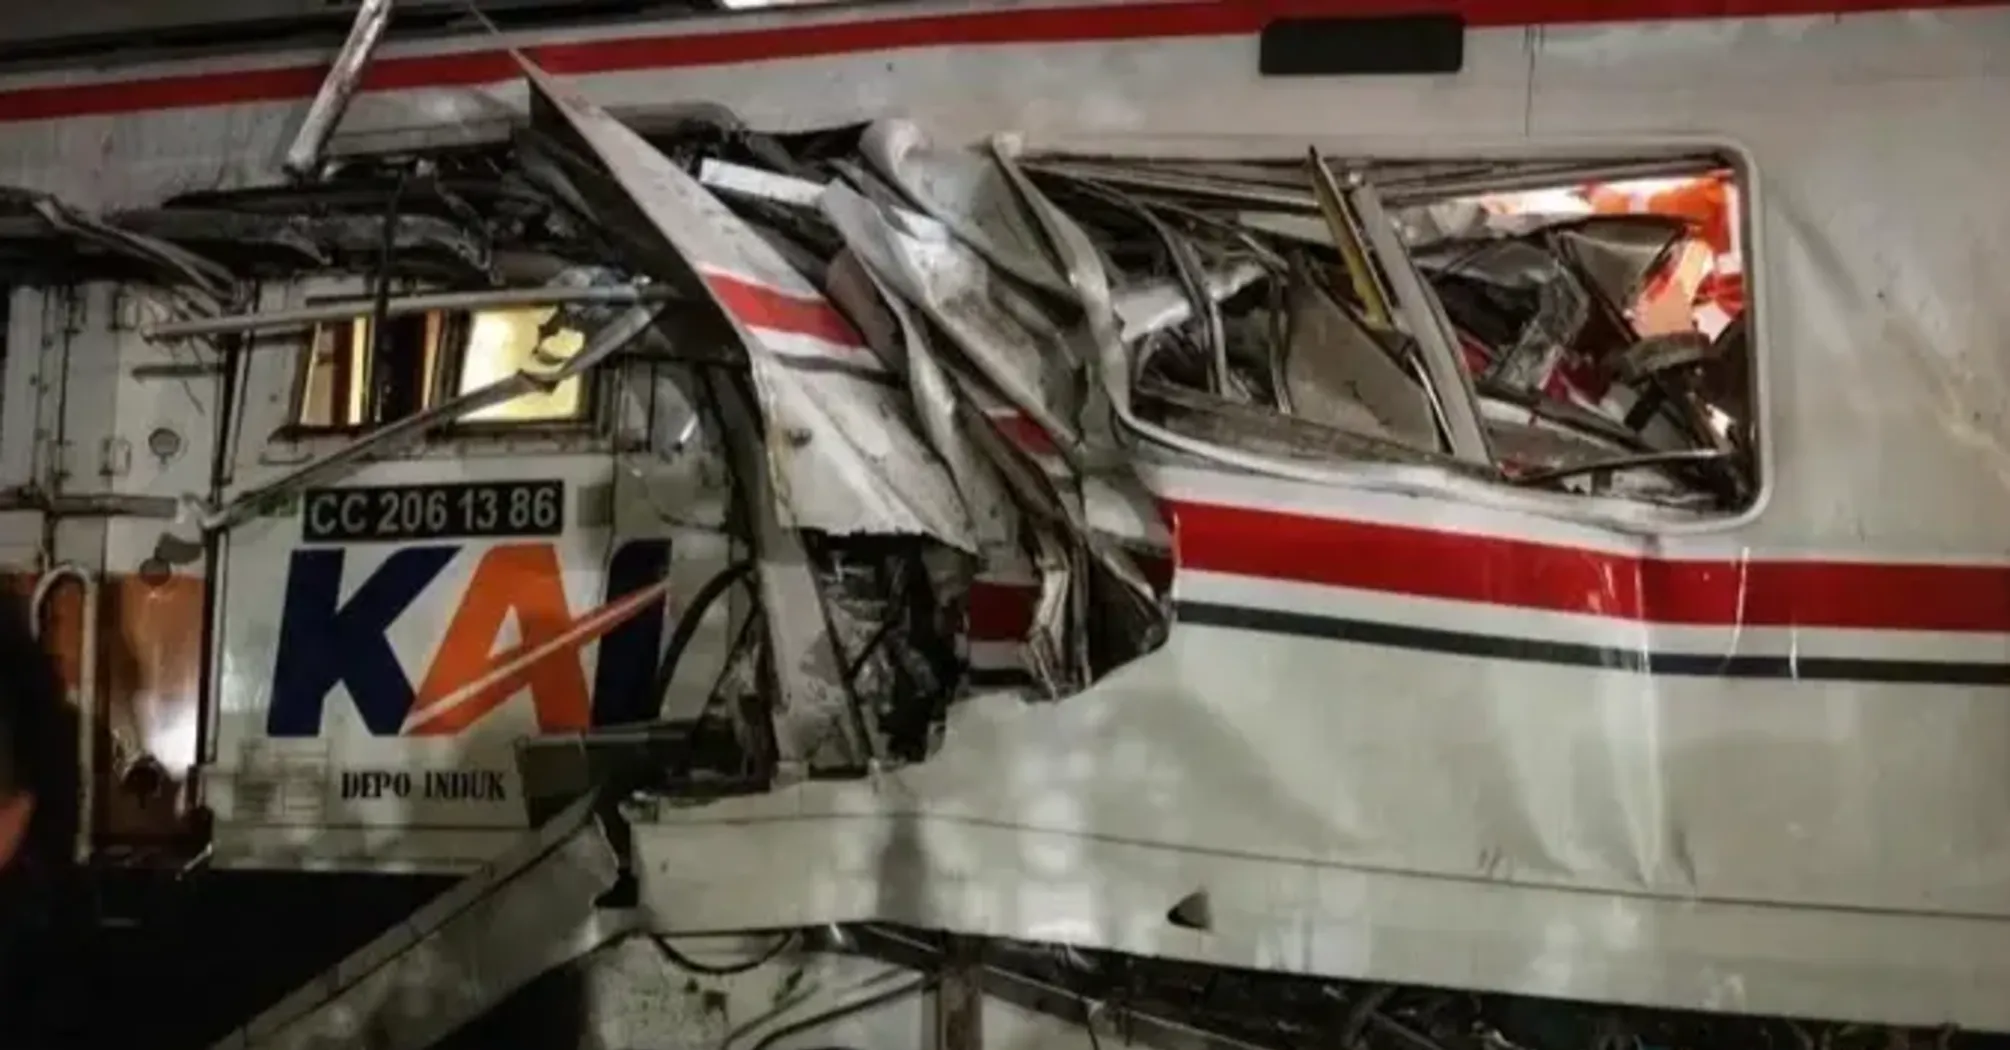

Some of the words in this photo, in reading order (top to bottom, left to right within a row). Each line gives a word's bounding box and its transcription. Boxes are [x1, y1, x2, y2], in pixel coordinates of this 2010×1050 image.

[310, 493, 368, 534] CC
[376, 490, 447, 532] 206
[457, 488, 498, 530] 13
[509, 486, 556, 528] 86
[266, 540, 673, 738] KAI
[341, 770, 411, 799] DEPO
[425, 769, 506, 799] INDUK
